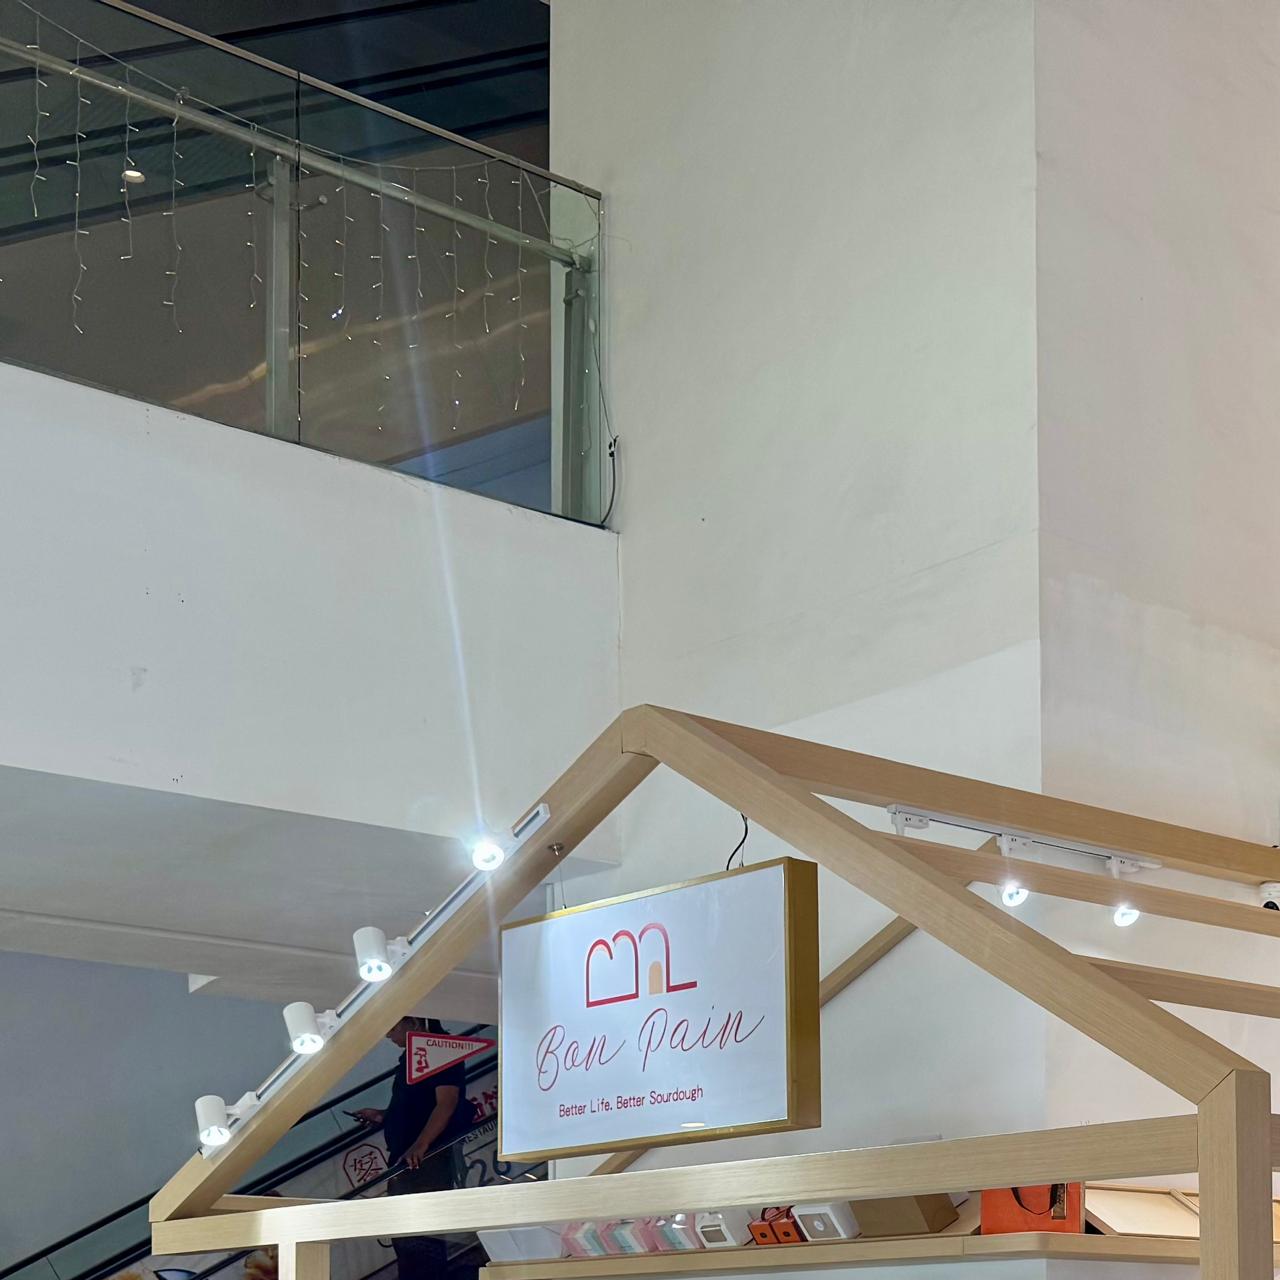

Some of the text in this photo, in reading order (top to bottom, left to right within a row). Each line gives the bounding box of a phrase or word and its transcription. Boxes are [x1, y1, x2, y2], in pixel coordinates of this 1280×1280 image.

[536, 1005, 765, 1092] Bon Pain
[559, 1084, 704, 1118] Better Life. Better Sourdough
